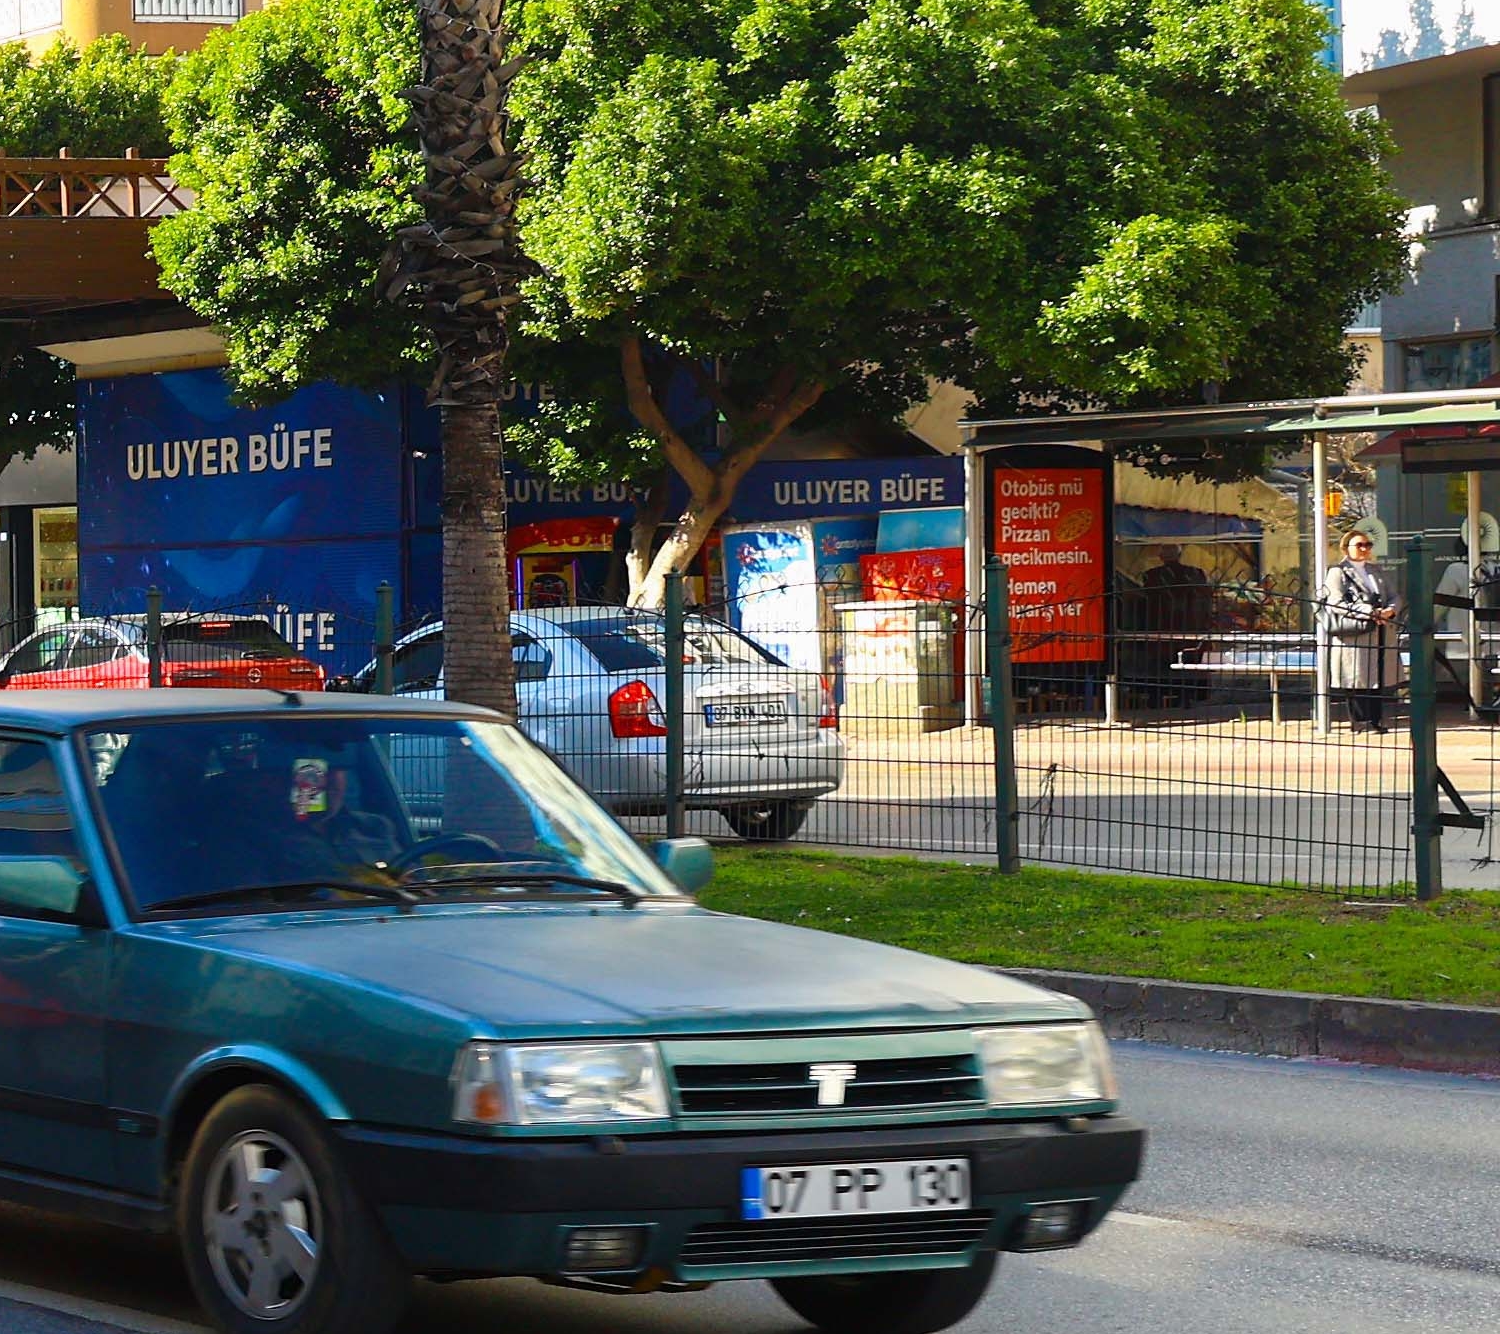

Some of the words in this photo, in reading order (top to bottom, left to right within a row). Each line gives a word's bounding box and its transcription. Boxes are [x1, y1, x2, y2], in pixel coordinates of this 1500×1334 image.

[127, 436, 239, 481] ULUYER
[249, 423, 333, 473] BÜFE
[774, 479, 870, 505] ULUYER
[881, 473, 946, 503] BÜFE
[1001, 478, 1055, 497] Otobüs
[1059, 478, 1084, 496] mü
[1001, 502, 1061, 524] gecikti?
[1002, 525, 1051, 543] Pizzan
[1002, 547, 1093, 567] gecikmesin.
[768, 1170, 810, 1214] 07
[831, 1167, 884, 1211] PP
[908, 1163, 966, 1208] 130
